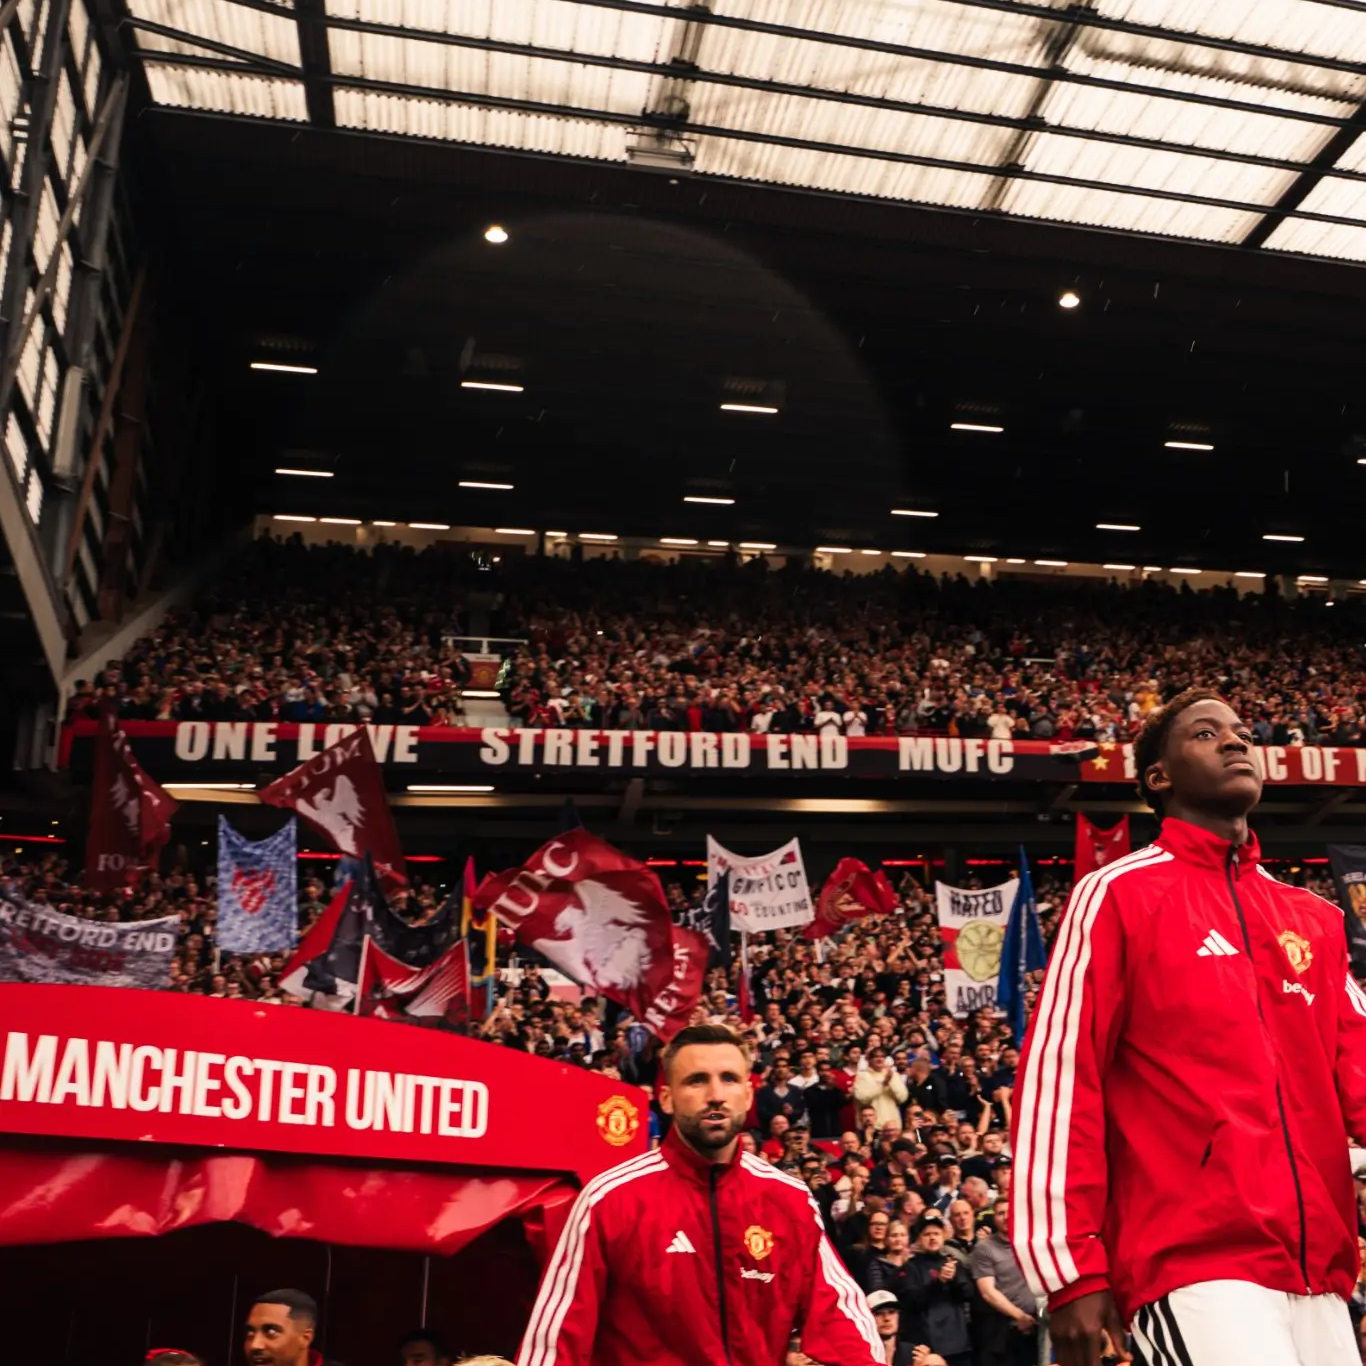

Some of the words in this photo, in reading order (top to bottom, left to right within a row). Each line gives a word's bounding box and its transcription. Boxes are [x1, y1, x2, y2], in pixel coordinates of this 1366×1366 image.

[174, 721, 278, 762] ONE
[479, 727, 751, 769] STRETFORD
[766, 733, 849, 770] END
[898, 737, 1015, 775] MUFC
[1301, 745, 1342, 783] OF
[950, 890, 1004, 917] HATED
[122, 932, 176, 953] END
[0, 1031, 338, 1127] MANCHESTER
[345, 1068, 490, 1139] UNITED
